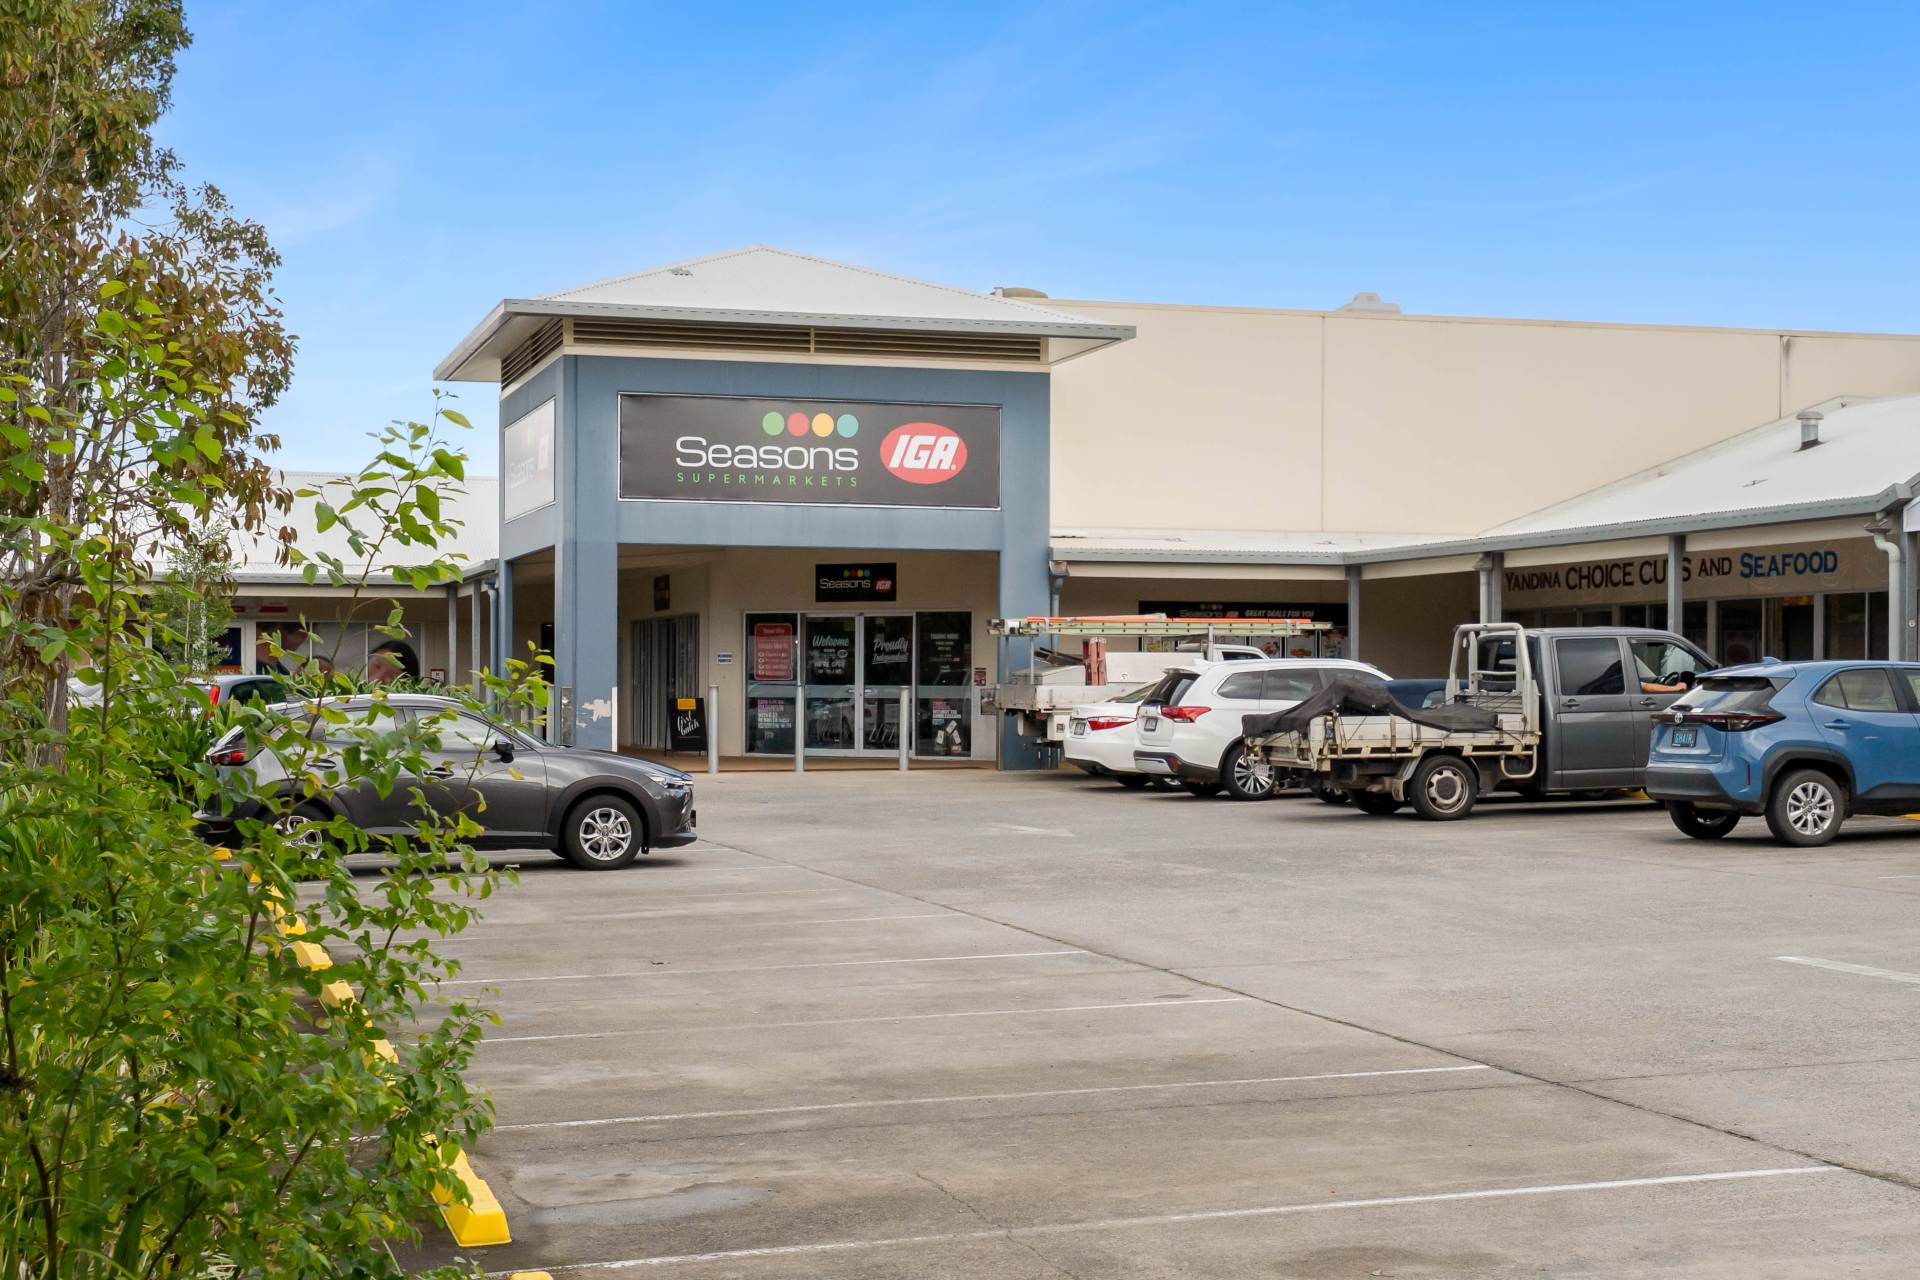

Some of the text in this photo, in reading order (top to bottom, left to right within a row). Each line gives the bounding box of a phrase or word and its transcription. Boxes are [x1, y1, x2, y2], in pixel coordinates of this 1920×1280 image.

[675, 436, 859, 471] Seasons
[889, 434, 960, 470] IGA
[676, 472, 858, 488] SUPERMARKETS
[1506, 550, 1838, 592] YANDINA CHOICE CUS AND SEAFOOD
[819, 578, 871, 589] Seasons
[812, 635, 849, 647] Welcome
[873, 637, 909, 651] Proudly
